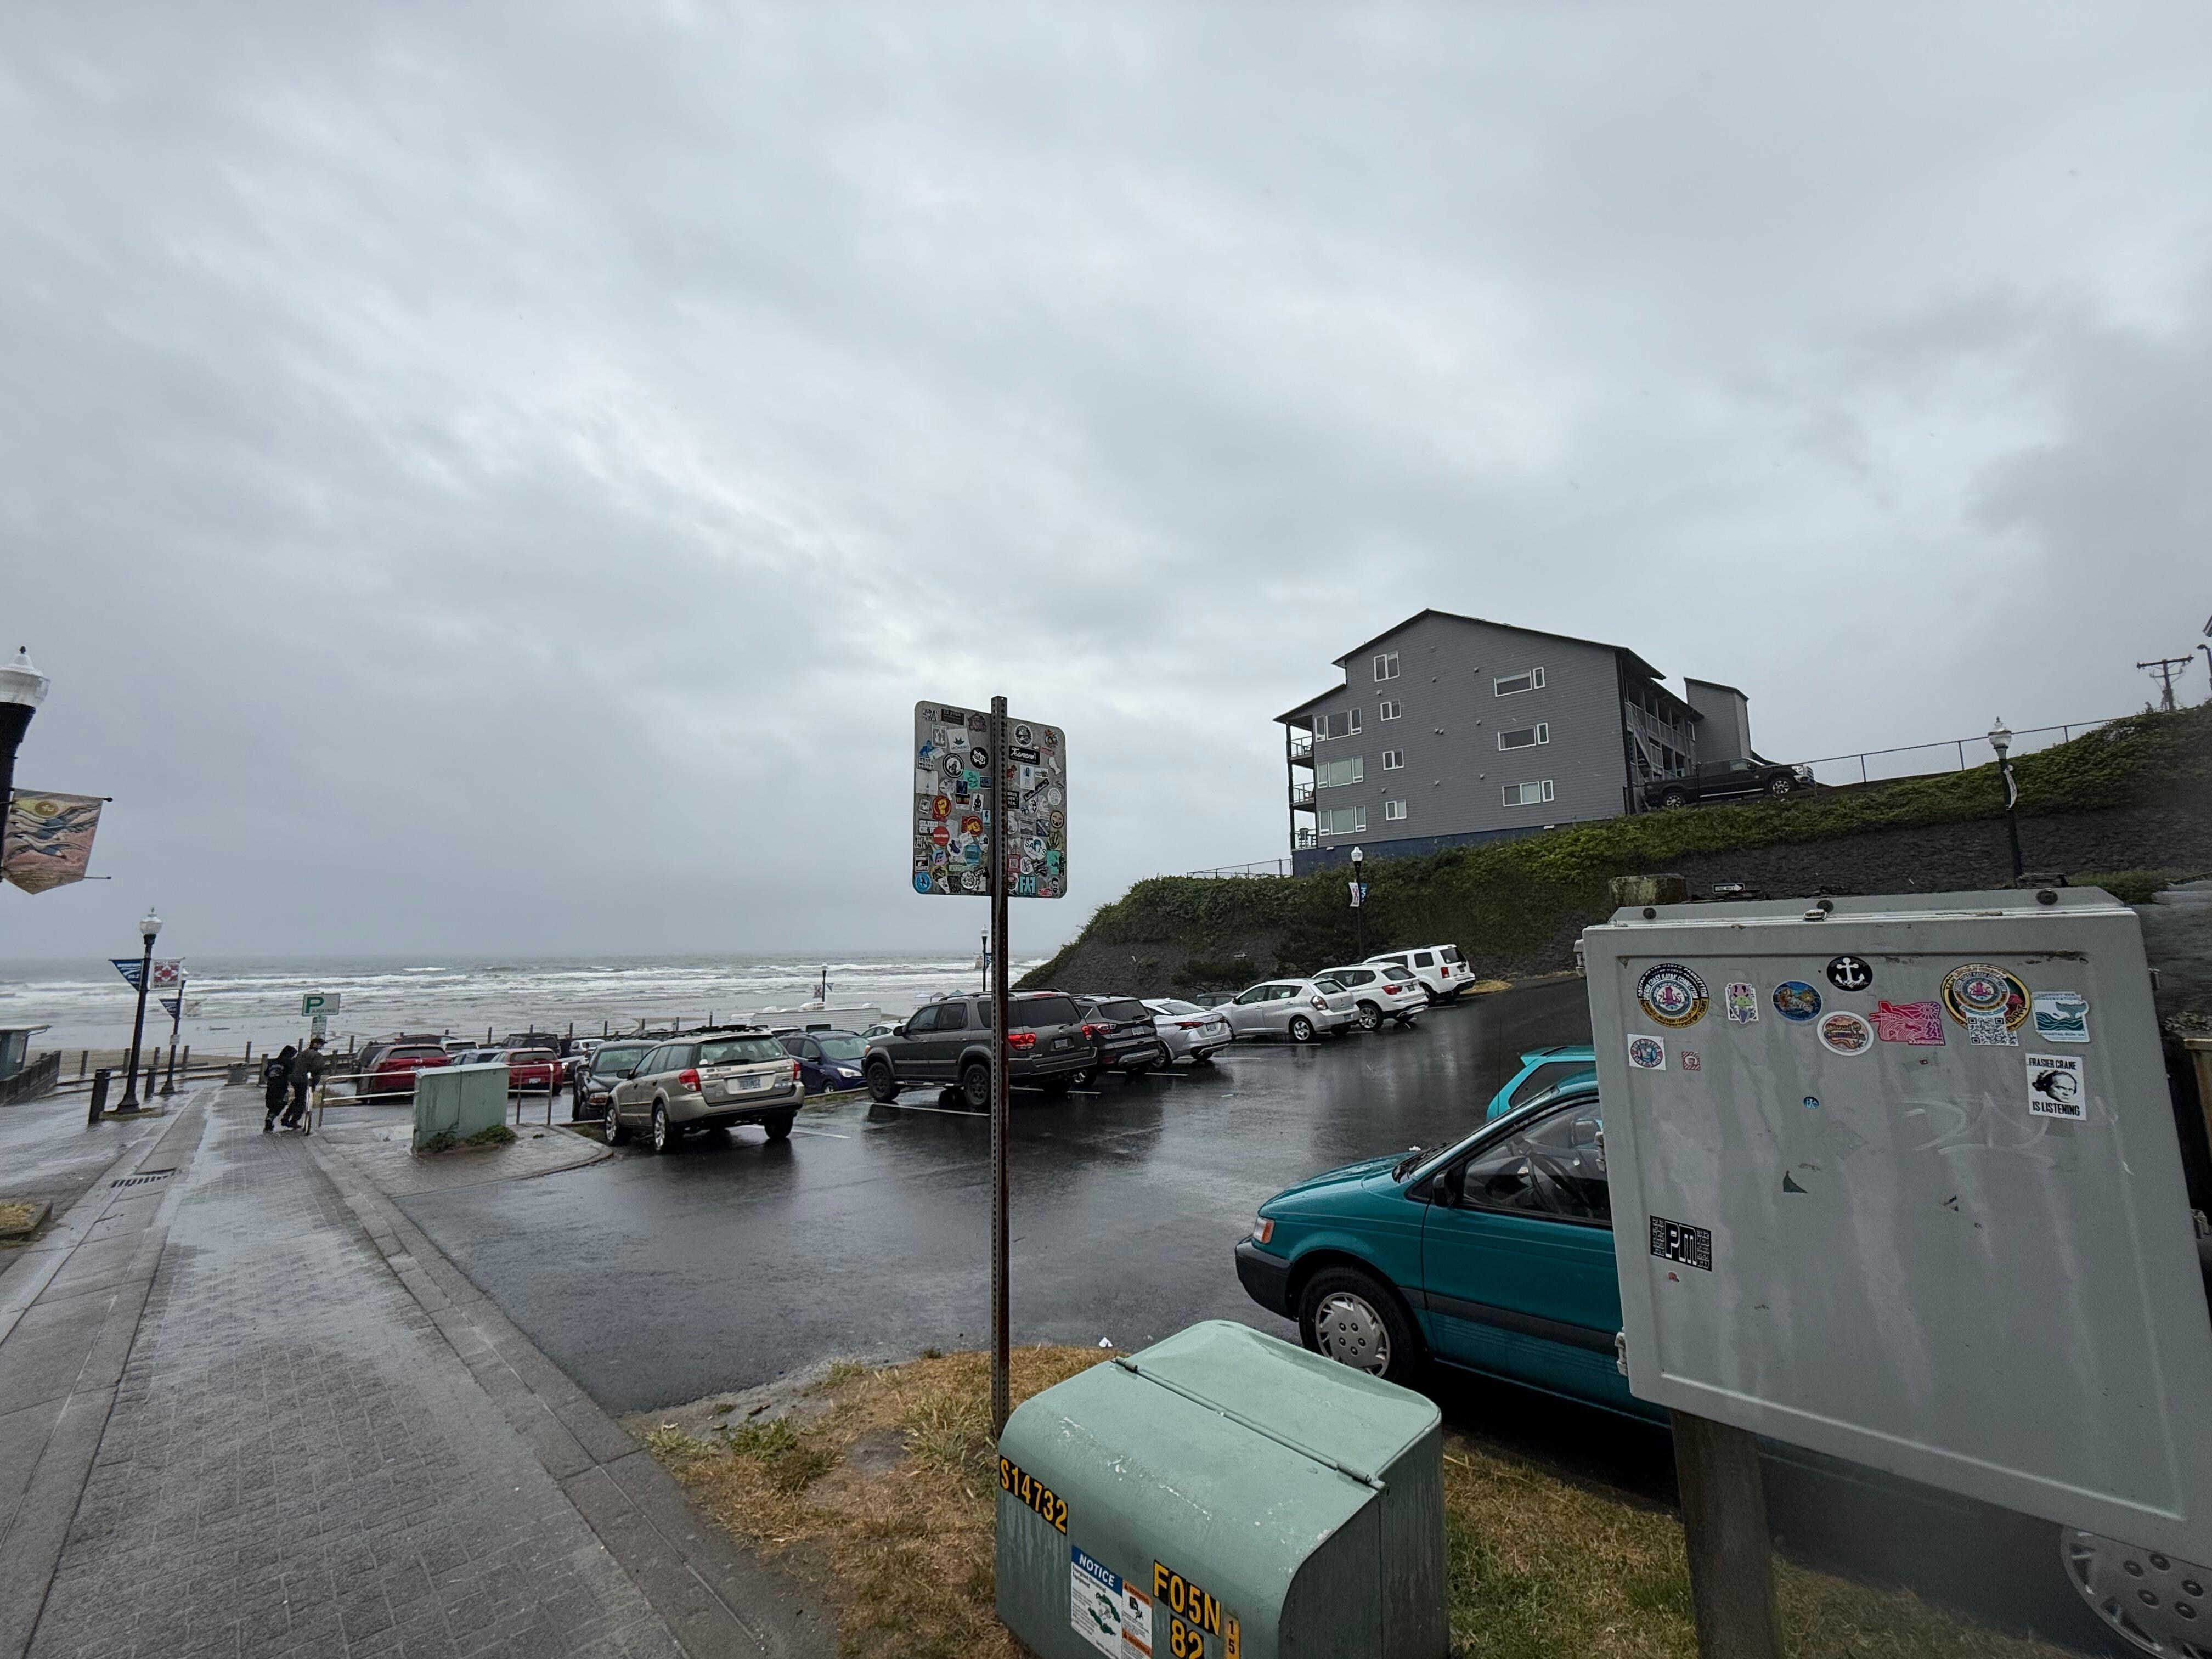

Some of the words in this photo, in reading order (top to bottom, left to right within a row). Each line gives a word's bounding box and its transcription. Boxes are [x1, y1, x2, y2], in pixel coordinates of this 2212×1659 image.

[1648, 975, 1661, 986] COAST
[1677, 976, 1700, 998] CONNECTION
[2029, 1058, 2055, 1068] FRASIER
[2055, 1060, 2076, 1070] CRANE
[2032, 1101, 2041, 1111] IS
[2041, 1102, 2080, 1116] LISTENING
[1000, 1459, 1067, 1534] S14732
[1079, 1553, 1115, 1587] NOTICE
[1171, 1619, 1203, 1659] 82
